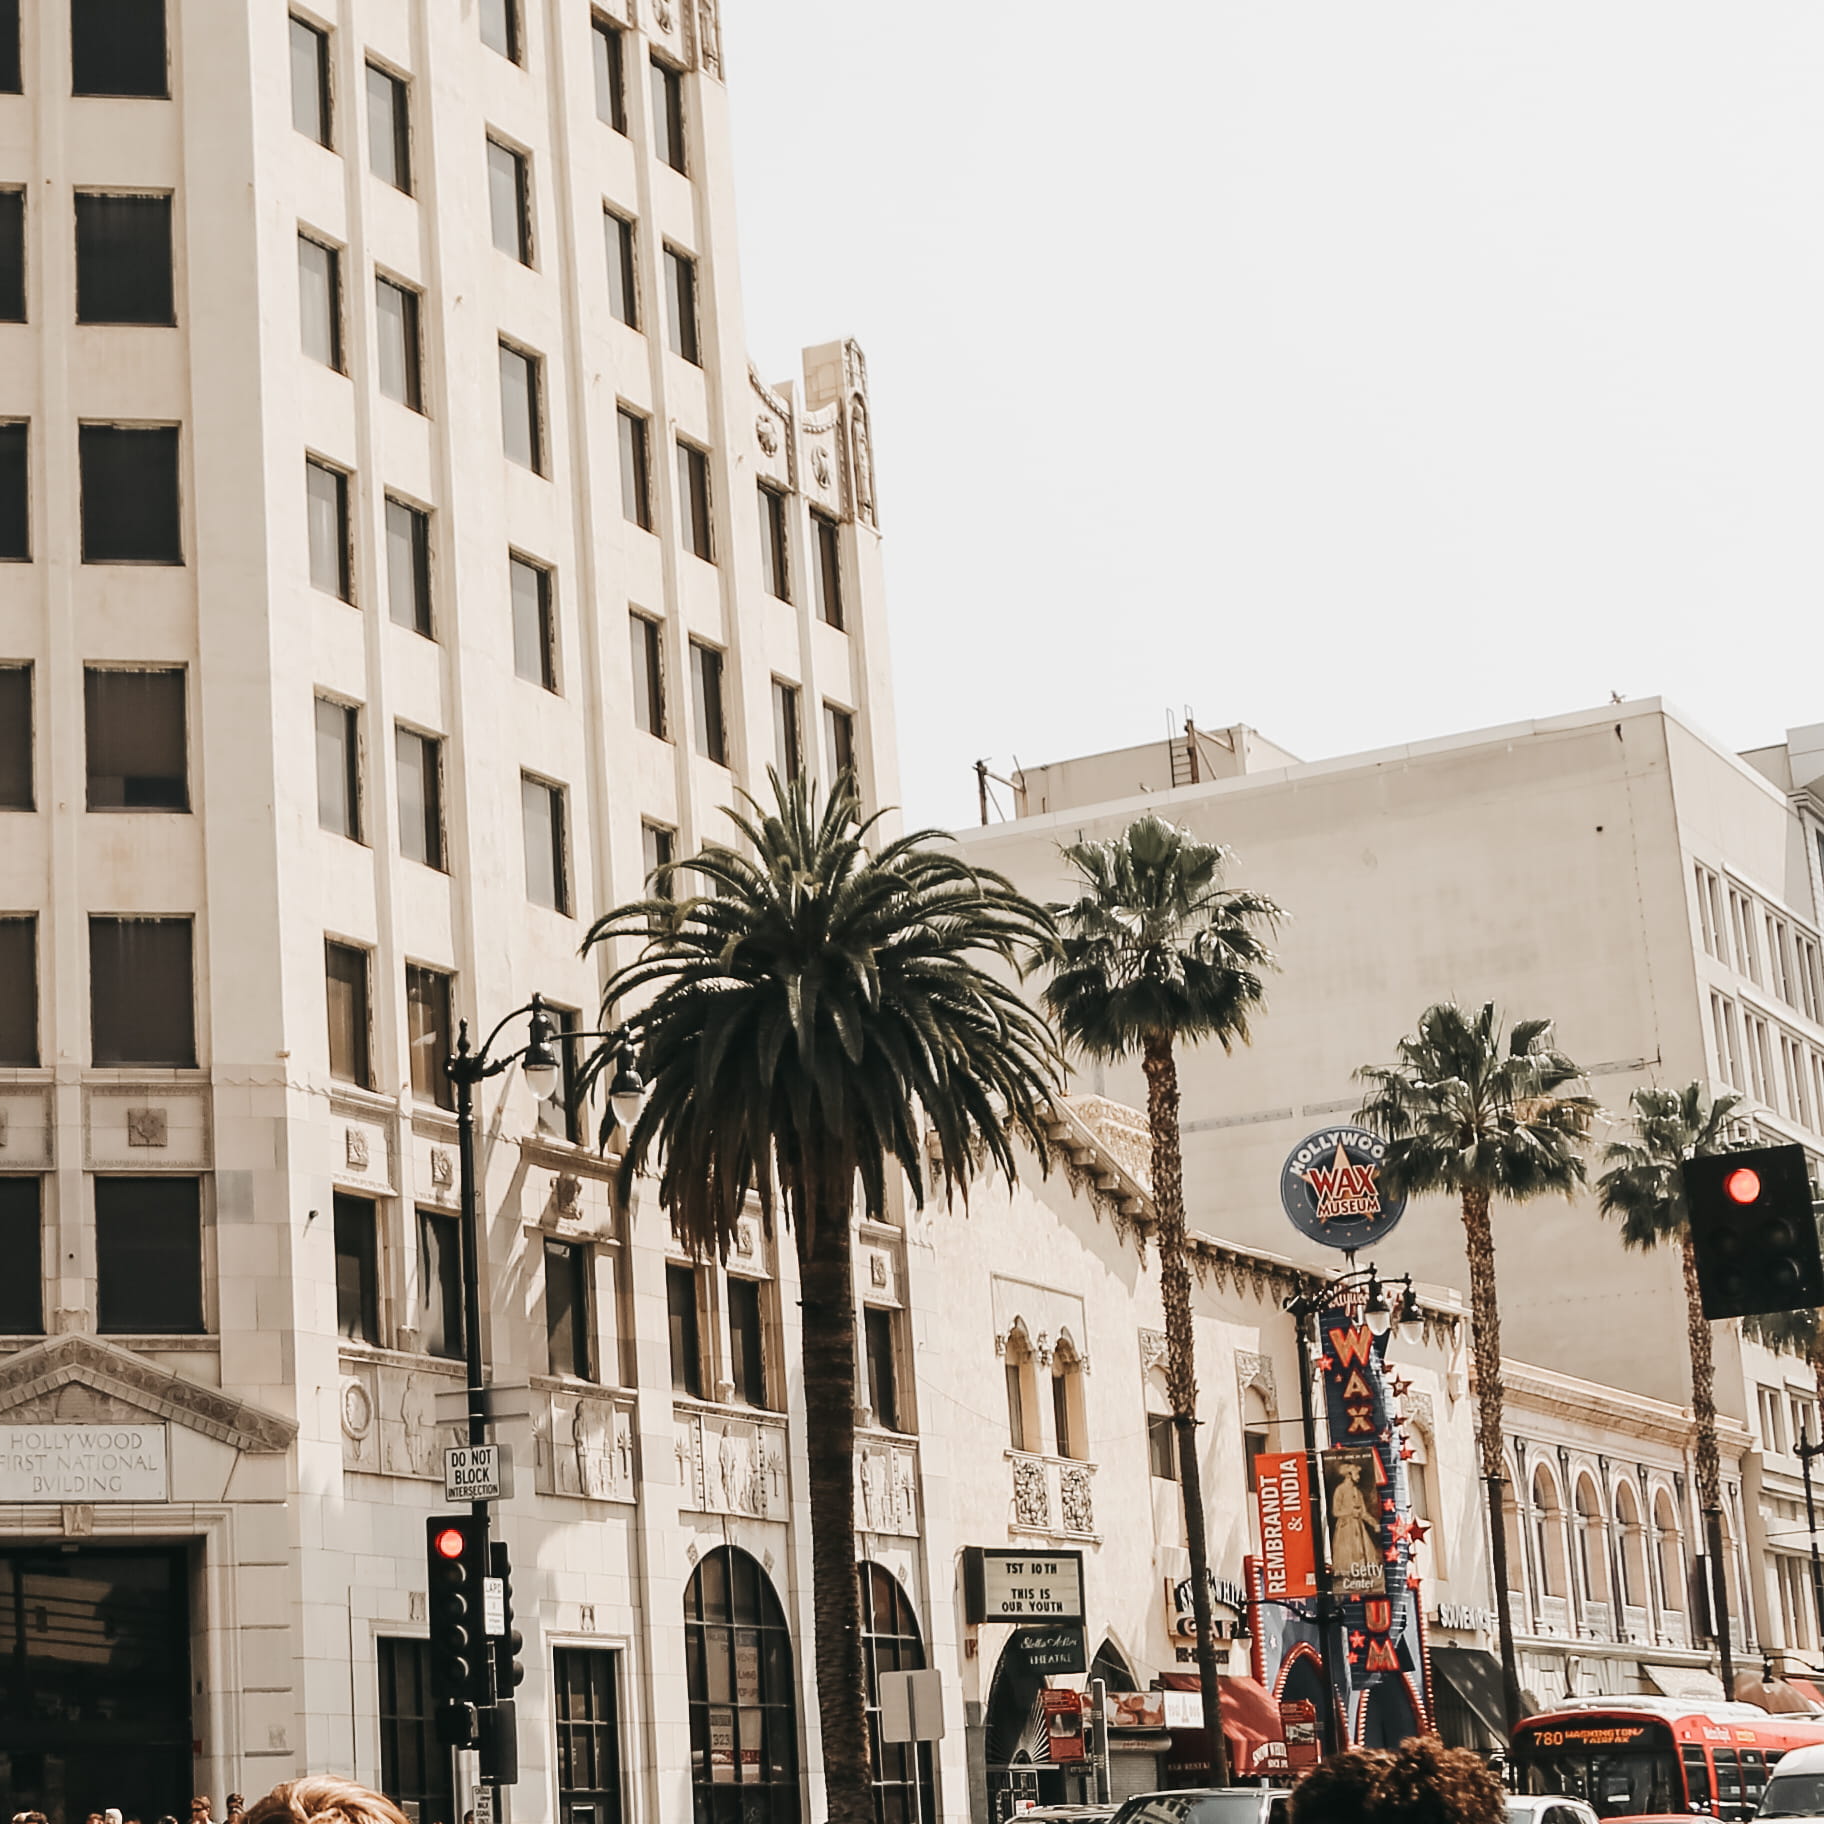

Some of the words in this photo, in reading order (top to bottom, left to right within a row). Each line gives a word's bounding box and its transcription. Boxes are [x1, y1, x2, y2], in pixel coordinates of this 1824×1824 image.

[1289, 1132, 1385, 1175] HOLLYWOO
[1307, 1164, 1379, 1201] WAX
[1317, 1197, 1381, 1217] MUSEUM
[1329, 1324, 1374, 1434] WAX
[11, 1432, 142, 1450] HOLLYWOOD
[57, 1454, 158, 1471] NATIONAL
[452, 1452, 466, 1467] DO
[472, 1449, 491, 1465] NOT
[455, 1467, 490, 1484] BLOCK
[448, 1484, 497, 1497] INTERSECTION
[1280, 1459, 1302, 1512] INDIA
[1288, 1517, 1303, 1532] &
[1260, 1475, 1287, 1594] REMBRANDT
[1351, 1562, 1383, 1578] Getty
[1342, 1578, 1374, 1590] Center
[1011, 1588, 1034, 1599] THIS
[1040, 1588, 1050, 1599] IS
[1002, 1602, 1023, 1612] OUR
[1029, 1602, 1063, 1612] YOUTH
[714, 1734, 729, 1745] 323
[1533, 1731, 1564, 1746] 780
[1583, 1736, 1630, 1745] FAIRFAX
